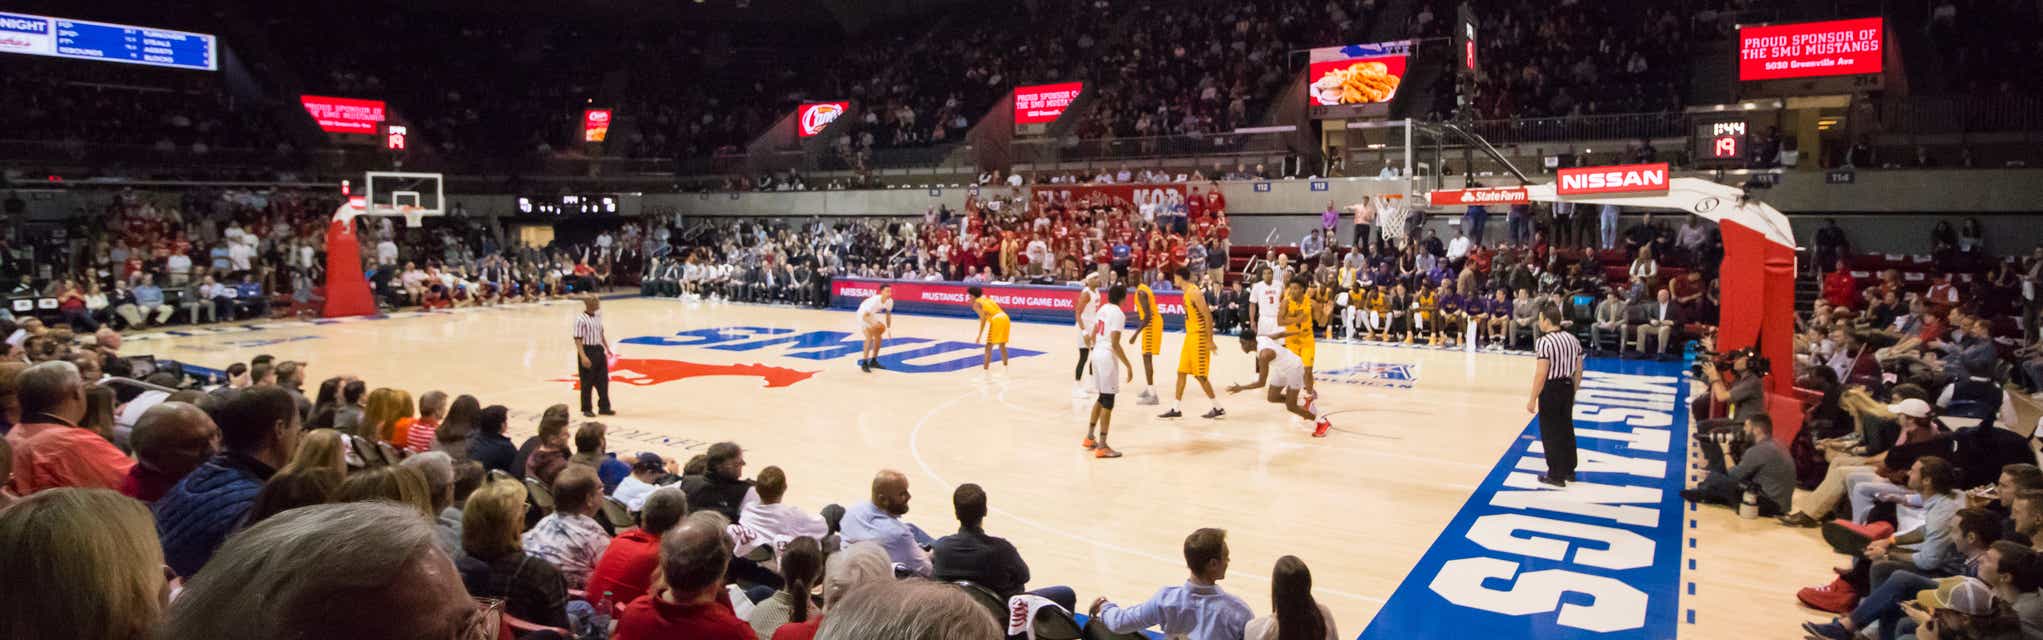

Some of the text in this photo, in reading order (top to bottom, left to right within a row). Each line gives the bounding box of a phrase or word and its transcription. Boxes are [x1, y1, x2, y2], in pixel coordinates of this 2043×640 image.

[1744, 29, 1876, 49] PROUD SPONSOR OF
[1742, 40, 1879, 60] THE SMU MUSTANGS
[1790, 58, 1835, 69] Greenville
[1837, 57, 1855, 66] Ave
[1713, 122, 1745, 136] 1:44
[1716, 138, 1735, 156] 19
[1563, 169, 1663, 190] NISSAN
[840, 287, 877, 297] NISSAN
[922, 292, 964, 302] MUSTANGS
[1013, 296, 1026, 305] ON
[1027, 297, 1052, 307] GAME
[618, 326, 1047, 373] SMU
[1428, 371, 1679, 633] MUSTANGS
